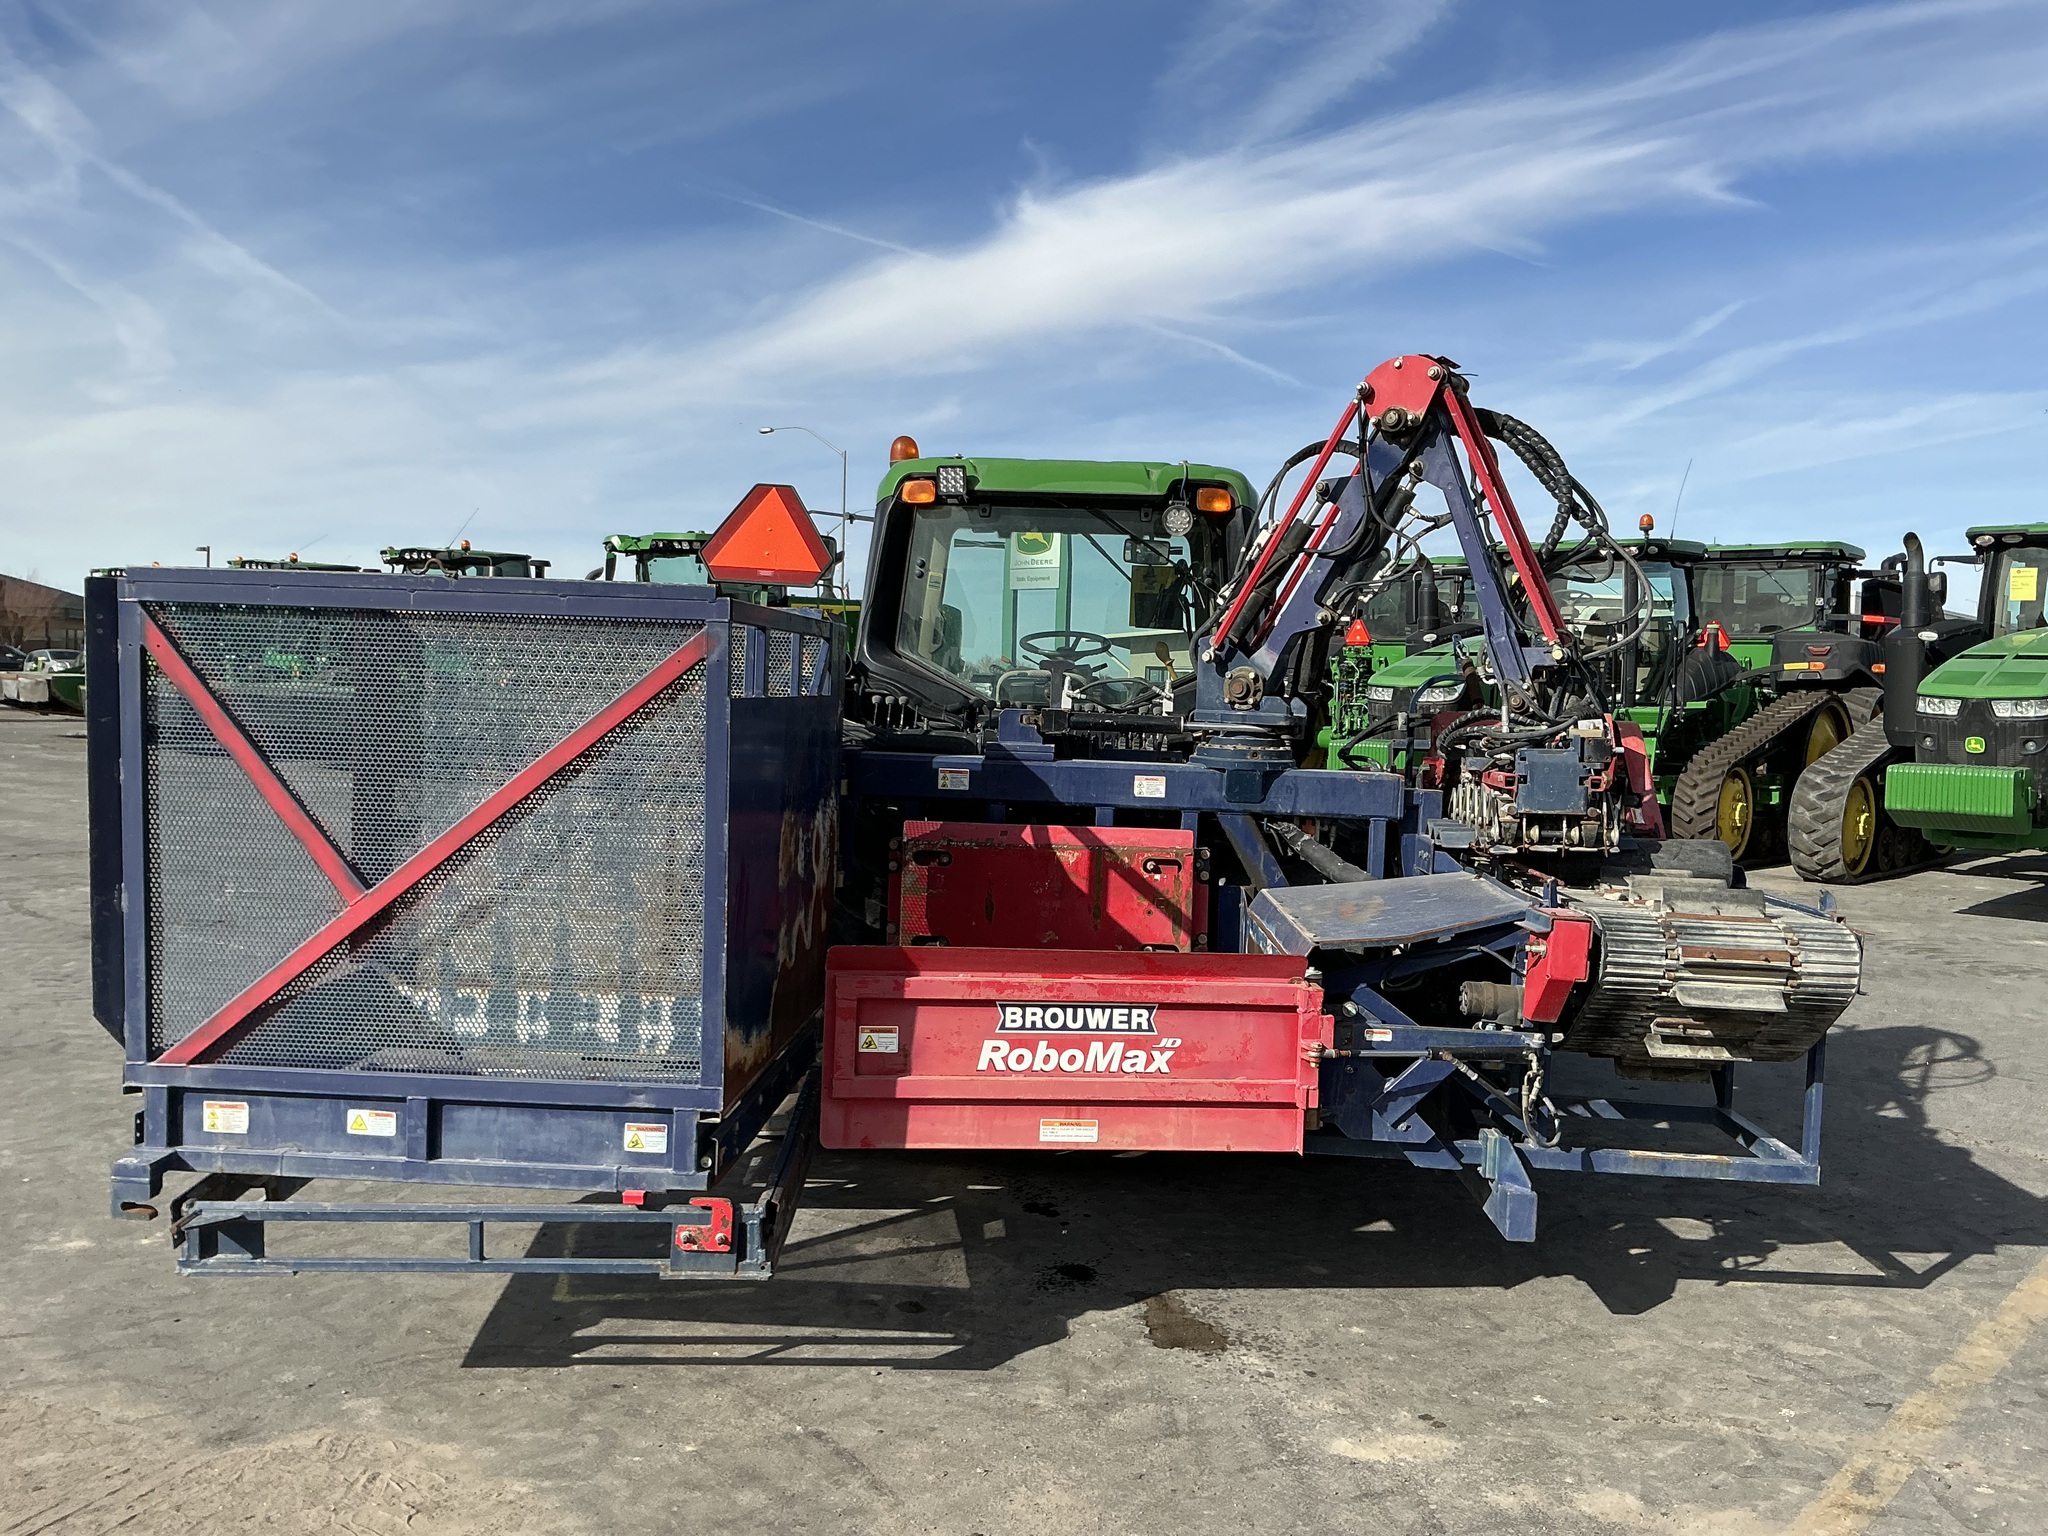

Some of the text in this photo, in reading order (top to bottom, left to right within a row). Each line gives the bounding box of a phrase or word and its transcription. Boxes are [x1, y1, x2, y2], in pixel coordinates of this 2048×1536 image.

[1004, 1006, 1150, 1030] BROUWER
[976, 1037, 1183, 1074] RoboMax JD
